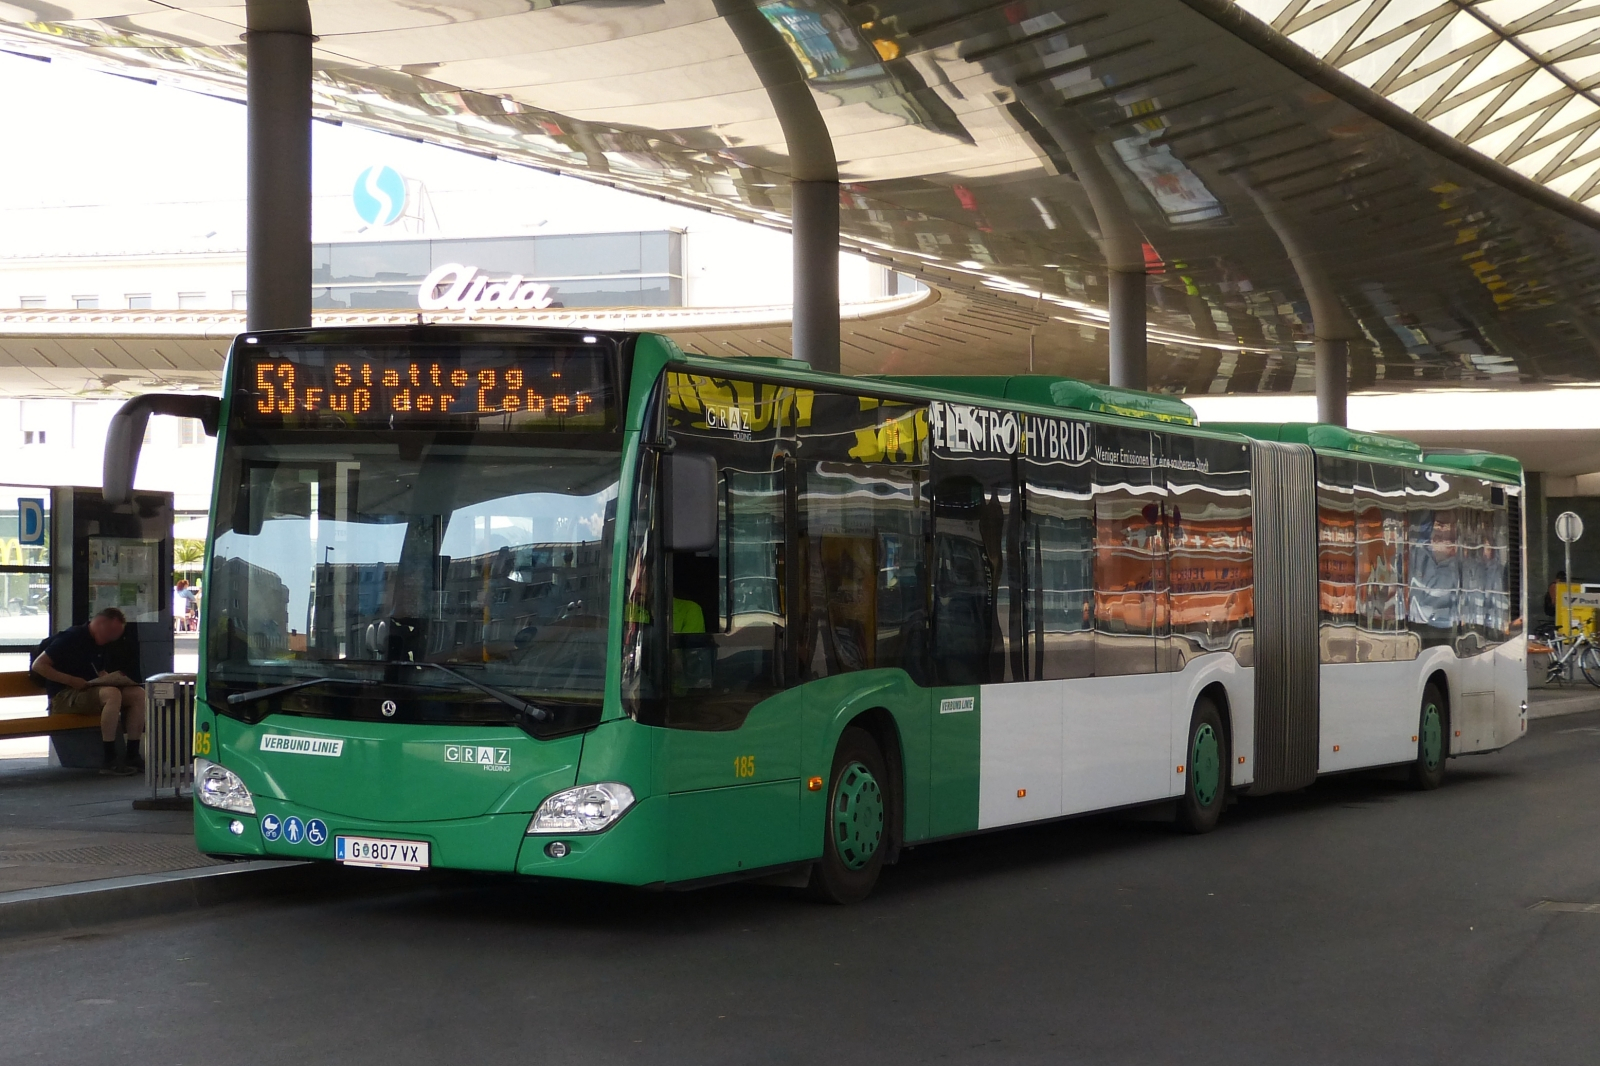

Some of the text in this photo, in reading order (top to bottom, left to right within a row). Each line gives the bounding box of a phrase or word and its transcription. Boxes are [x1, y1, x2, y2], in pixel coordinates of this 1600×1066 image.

[257, 363, 296, 414] 53
[334, 363, 523, 390] Stattegg
[304, 388, 593, 414] Fuß der Leber
[707, 406, 750, 431] GRAZ
[1025, 415, 1088, 462] HYBRID
[1095, 445, 1120, 465] Weniger
[1120, 448, 1150, 466] Emissionen
[20, 501, 43, 542] D
[264, 737, 340, 754] VERBUND LINIE
[446, 747, 508, 764] GRAZ
[734, 755, 754, 778] 185
[352, 842, 360, 858] G
[371, 843, 398, 861] 807
[401, 845, 419, 863] VX
